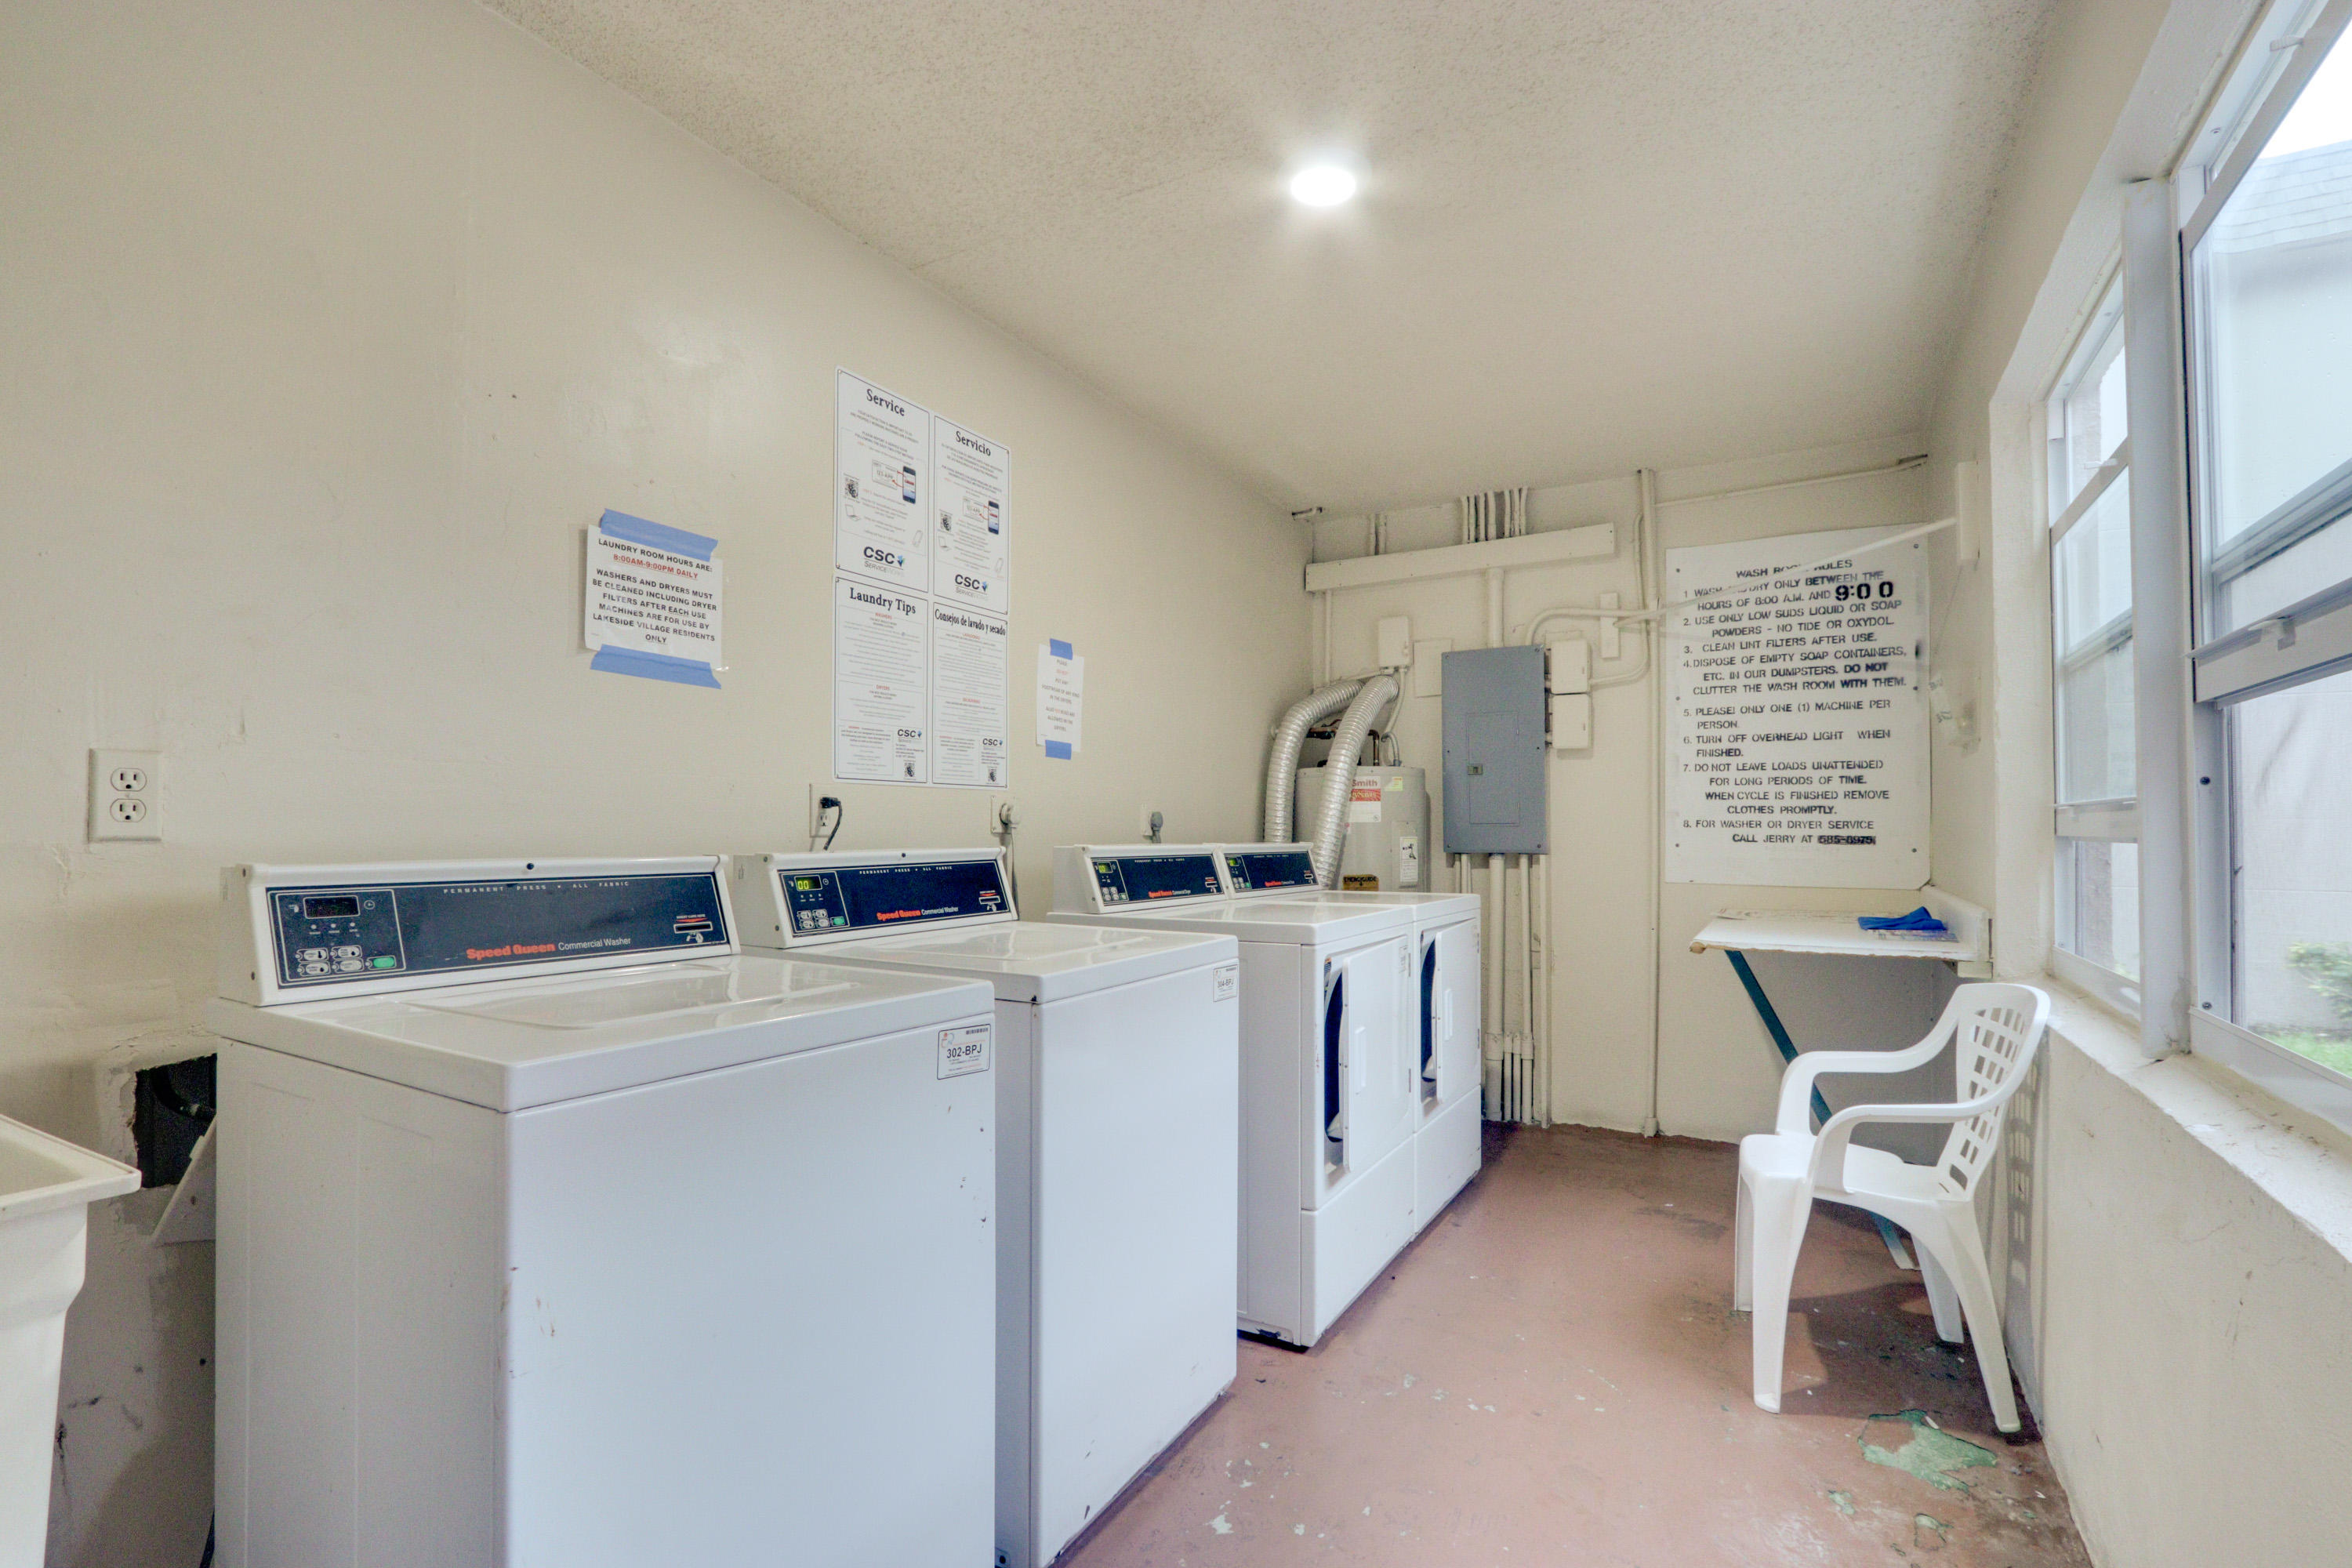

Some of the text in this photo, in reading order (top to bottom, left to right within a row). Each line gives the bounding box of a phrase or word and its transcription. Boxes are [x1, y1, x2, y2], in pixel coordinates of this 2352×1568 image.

[866, 389, 905, 416] Service
[956, 431, 991, 456] Servicio
[599, 539, 712, 572] LAUNDRY ROOM HOURS ARE:
[864, 546, 895, 564] CSC
[614, 554, 698, 579] 8:00AM-9:00PM DAILY
[1737, 568, 1768, 578] WASH
[597, 568, 713, 600] WASHERS AND DRYERS MUST
[955, 575, 980, 590] CSC
[1774, 579, 1800, 589] ONLY
[1806, 574, 1857, 586] BETWEEN
[1862, 571, 1884, 581] THE
[603, 593, 706, 619] FILTERS AFTER EACH USE
[605, 583, 643, 595] CLEANED
[647, 591, 689, 604] INCLUDING
[692, 601, 717, 611] DRYER
[850, 588, 916, 615] Laundry Tips
[1697, 601, 1732, 611] HOURS
[1737, 598, 1750, 607] OF
[1755, 596, 1778, 605] 8:00
[1809, 590, 1831, 601] AND
[599, 604, 643, 617] MACHINES
[646, 612, 662, 621] ARE
[664, 616, 679, 625] FOR
[682, 619, 697, 628] USE
[1695, 615, 1715, 625] USE
[1719, 613, 1744, 622] ONLY
[1748, 611, 1771, 620] LOW
[1775, 608, 1804, 618] SUDS
[1809, 604, 1844, 615] LIQUID
[1849, 603, 1865, 612] OR
[1871, 600, 1902, 611] SOAP
[593, 613, 715, 641] LAKESIDE VILLAGE RESIDENTS
[935, 609, 1005, 636] Consejos de lavado y secado
[1712, 626, 1762, 637] POWDERS
[1777, 623, 1792, 633] NO
[1798, 622, 1820, 630] TIDE
[1827, 619, 1842, 629] OR
[645, 634, 666, 644] ONLY
[1702, 642, 1735, 652] CLEAN
[1740, 641, 1762, 649] LINT
[1766, 637, 1806, 648] FILTERS
[1812, 635, 1846, 644] AFTER
[1852, 633, 1877, 642] USE.
[1693, 656, 1736, 667] DISPOSE
[1741, 655, 1755, 664] OF
[1760, 653, 1794, 663] EMPTY
[1800, 652, 1828, 661] SOAP
[1834, 646, 1907, 659] CONTAINERS,
[1704, 662, 1888, 681] ETC. IN OUR DUMPSTERS. DO NOT
[1693, 677, 1906, 695] CLUTTER THE WASH ROOM WITH THEM.
[1740, 705, 1765, 714] ONLY
[1770, 704, 1792, 713] ONE
[1798, 702, 1809, 713] (1)
[1815, 701, 1864, 710] MACHINE
[1869, 699, 1890, 709] PER
[898, 729, 916, 738] CSC
[1696, 735, 1722, 744] TURN
[1752, 732, 1807, 742] OVERHEAD
[1813, 731, 1844, 741] LIGHT
[1857, 730, 1890, 739] WHEN
[1697, 748, 1744, 757] FINISHED.
[1711, 763, 1731, 771] NOT
[1772, 762, 1806, 771] LOADS
[1812, 760, 1883, 770] UNATTENDED
[1710, 778, 1730, 786] FOR
[1768, 776, 1813, 785] PERIODS
[1775, 791, 1784, 800] IS
[1791, 791, 1838, 800] FINISHED
[1844, 790, 1889, 799] REMOVE
[1780, 805, 1837, 814] PROMPTLY.
[877, 911, 898, 921] Speed
[466, 938, 631, 960] Speed Queen Commercial Washer
[947, 1044, 982, 1058] 302-BPJ
